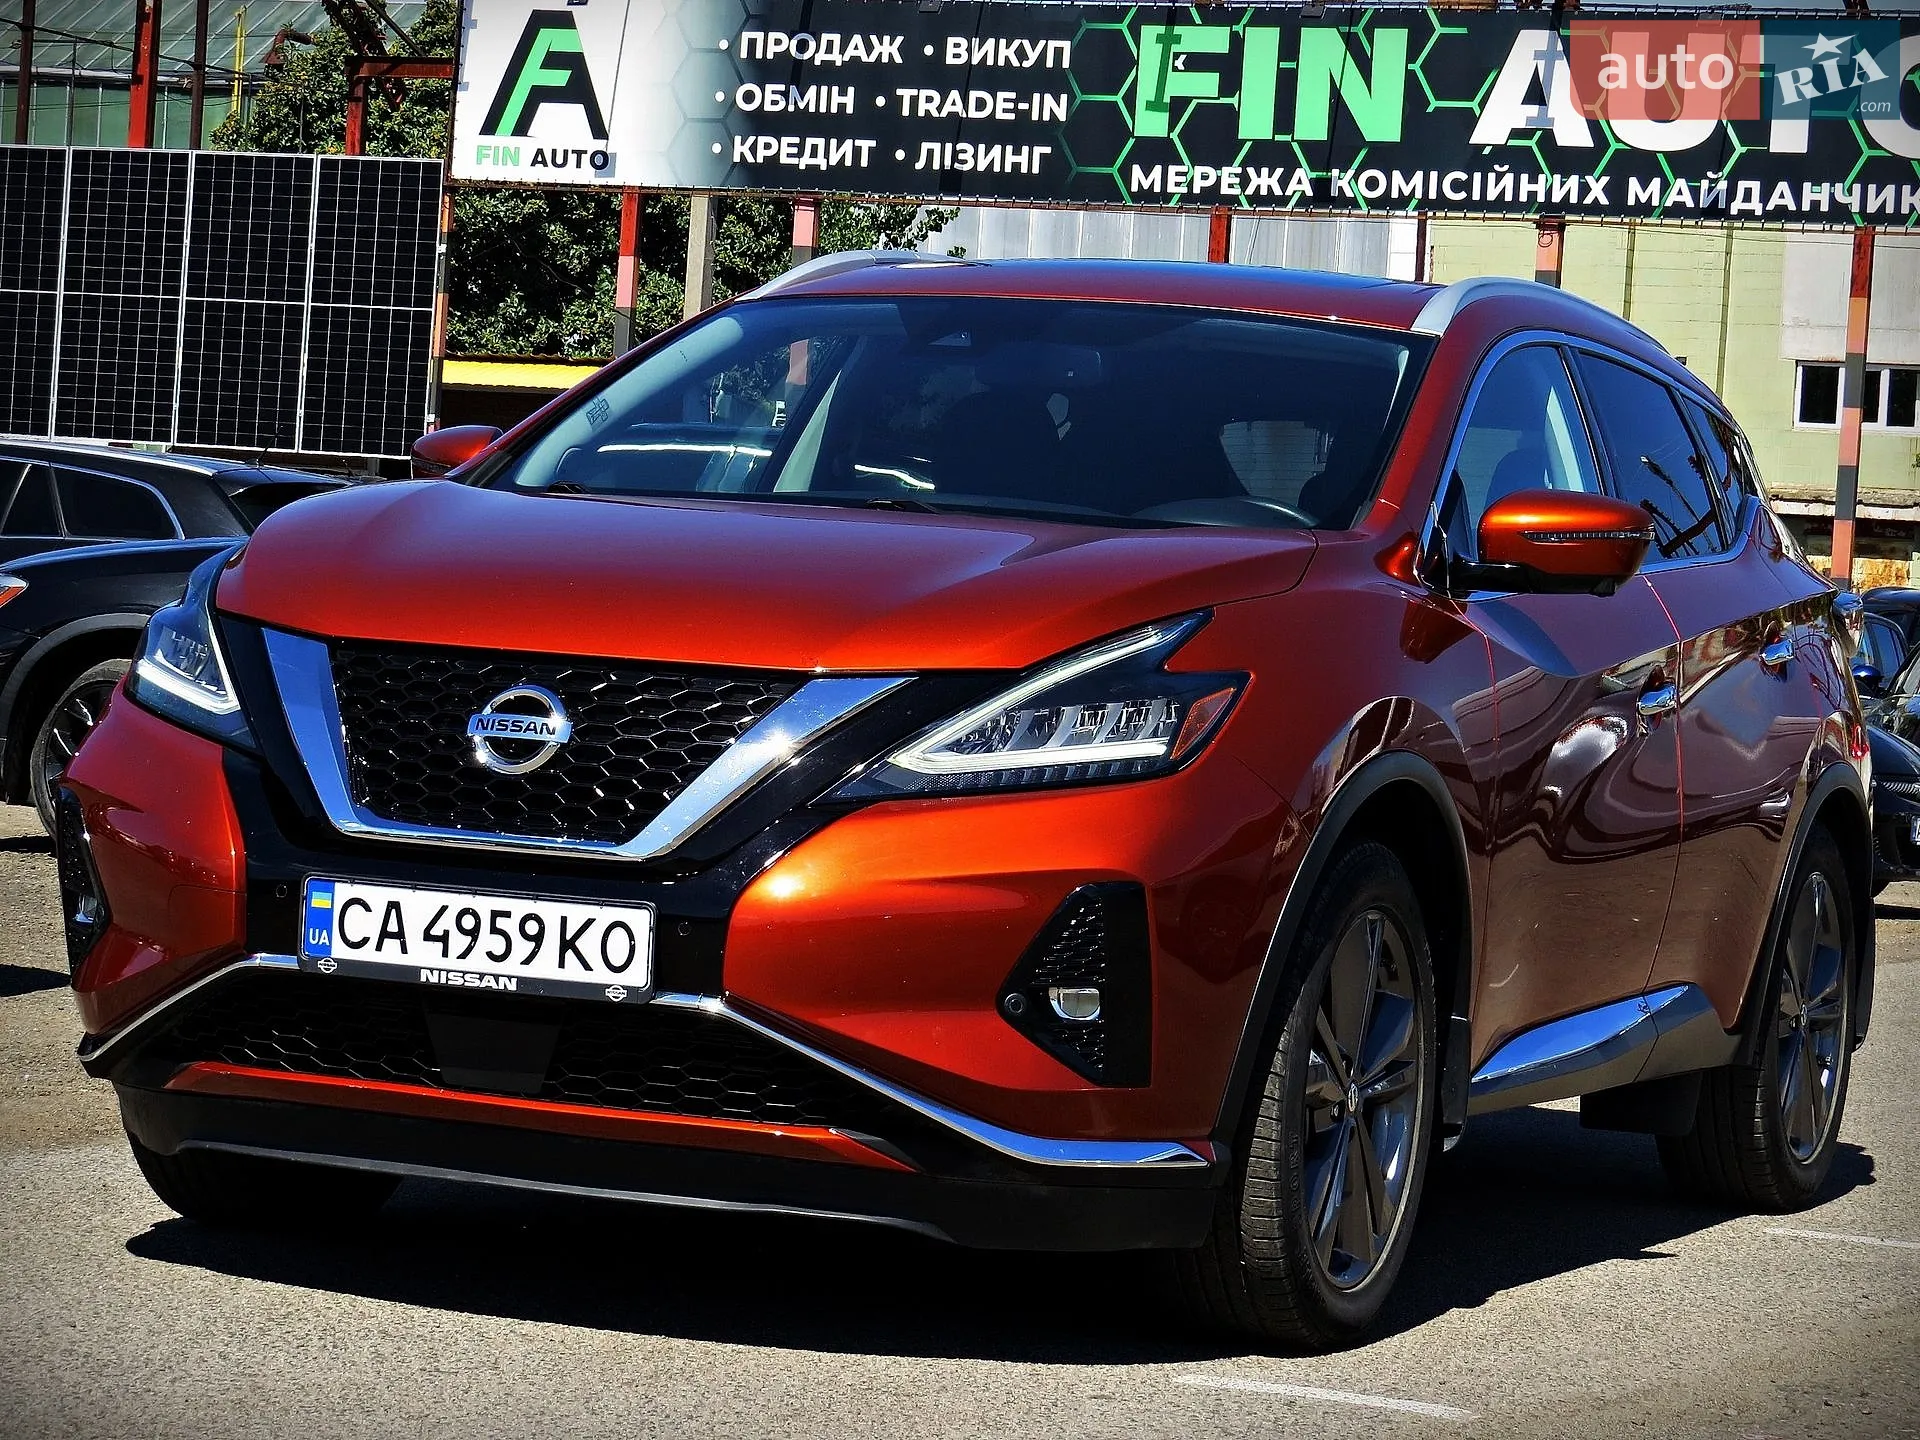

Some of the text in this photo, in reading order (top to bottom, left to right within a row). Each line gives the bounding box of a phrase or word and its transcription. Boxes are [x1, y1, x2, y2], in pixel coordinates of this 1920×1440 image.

[739, 32, 904, 65] ПРОДАЖ
[945, 37, 1072, 70] ВИКУП
[735, 82, 855, 115] ОБМІН
[1133, 25, 1408, 143] FIN
[896, 88, 1069, 123] TRADE-IN
[476, 145, 610, 171] FIN AUTO
[733, 136, 877, 170] КРЕДИТ
[914, 144, 1053, 176] ЛІЗИНГ
[1130, 164, 1314, 198] МЕРЕЖА
[1330, 163, 1612, 206] КОМІСІЙНИХ
[475, 717, 557, 736] NISSAN
[308, 927, 331, 946] UA
[338, 897, 637, 974] CA 4959 KO
[419, 968, 518, 991] NISSAN
